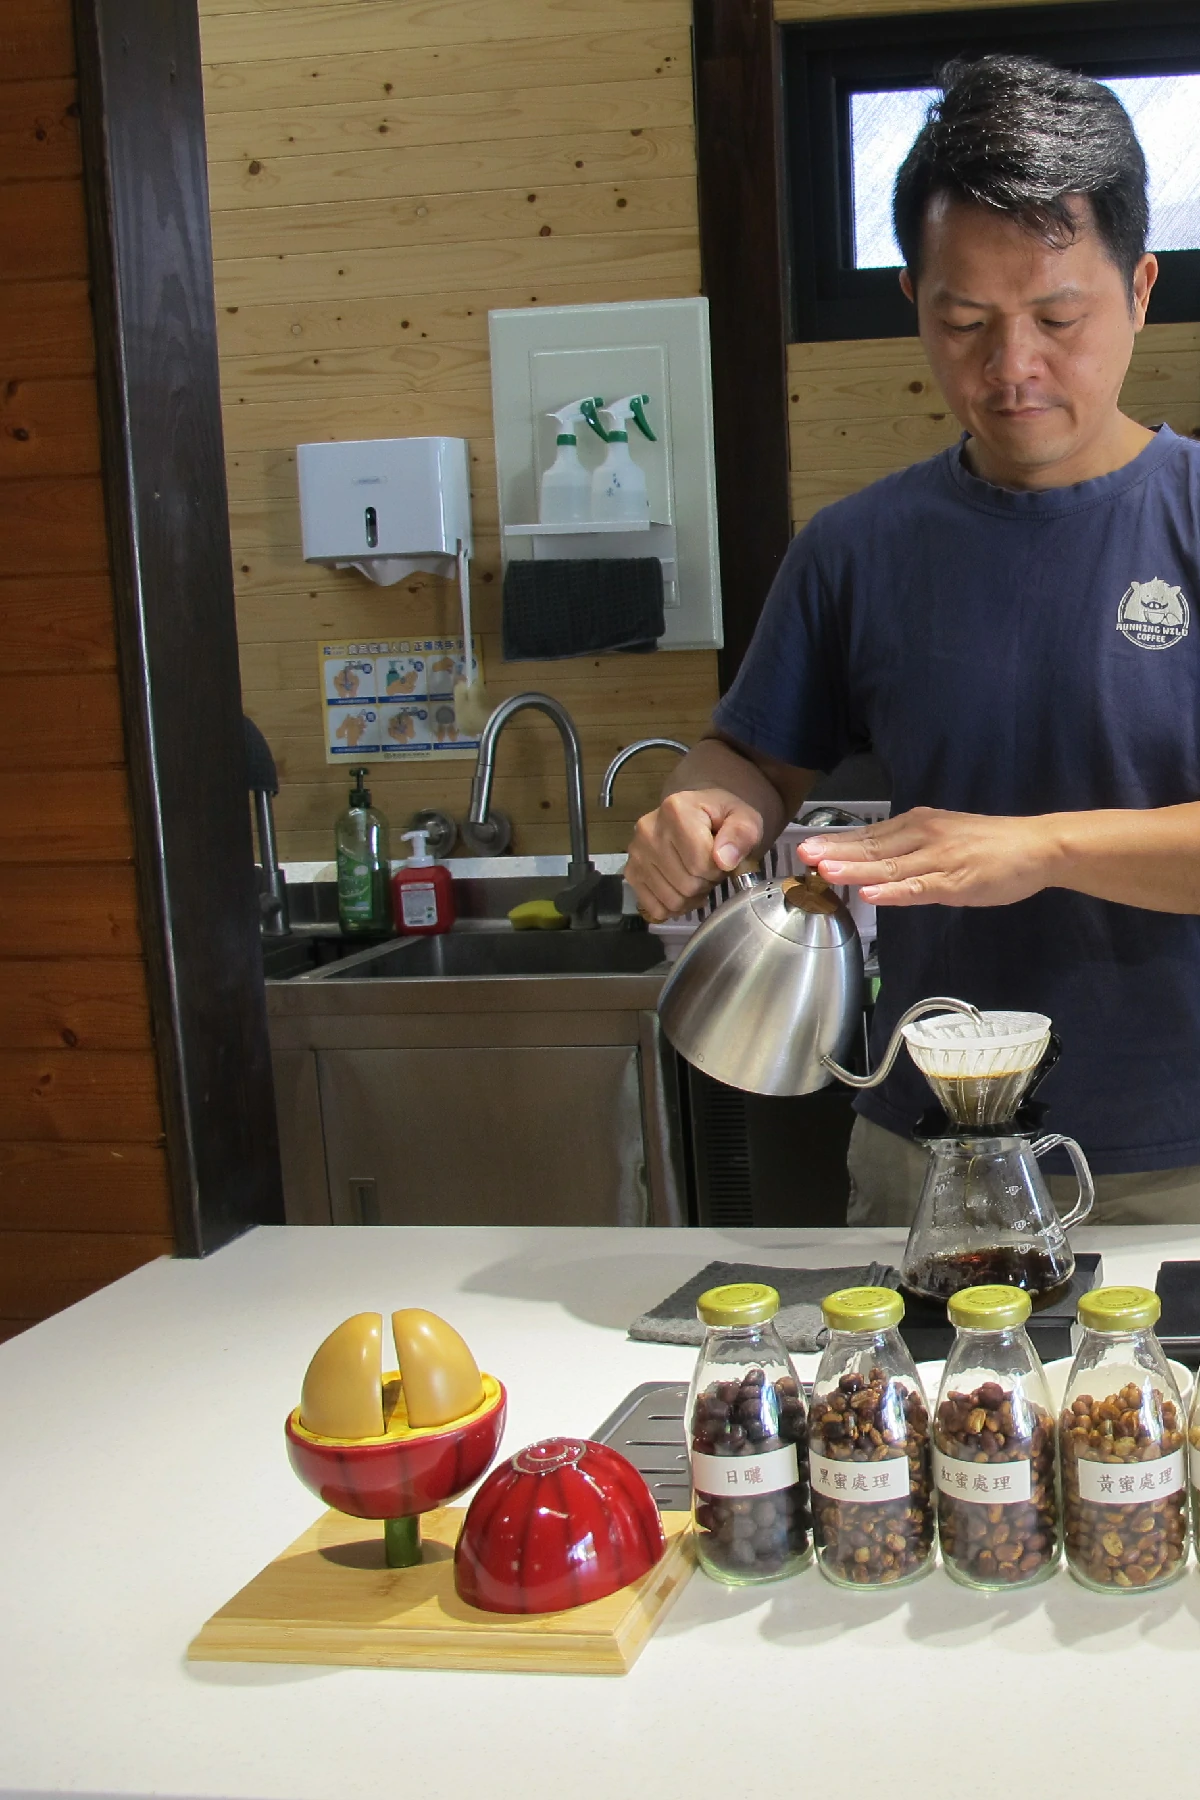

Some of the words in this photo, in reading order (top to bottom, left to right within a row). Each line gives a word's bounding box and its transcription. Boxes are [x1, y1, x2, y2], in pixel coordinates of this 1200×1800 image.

[1116, 623, 1160, 634] RUNNING
[1162, 627, 1188, 637] WILD
[1136, 632, 1166, 643] COFFEE
[726, 1465, 764, 1485] 日曬
[818, 1467, 891, 1492] 黑蜜處理
[940, 1465, 1013, 1492] 紅蜜處理
[1096, 1466, 1173, 1493] 黃蜜處理
